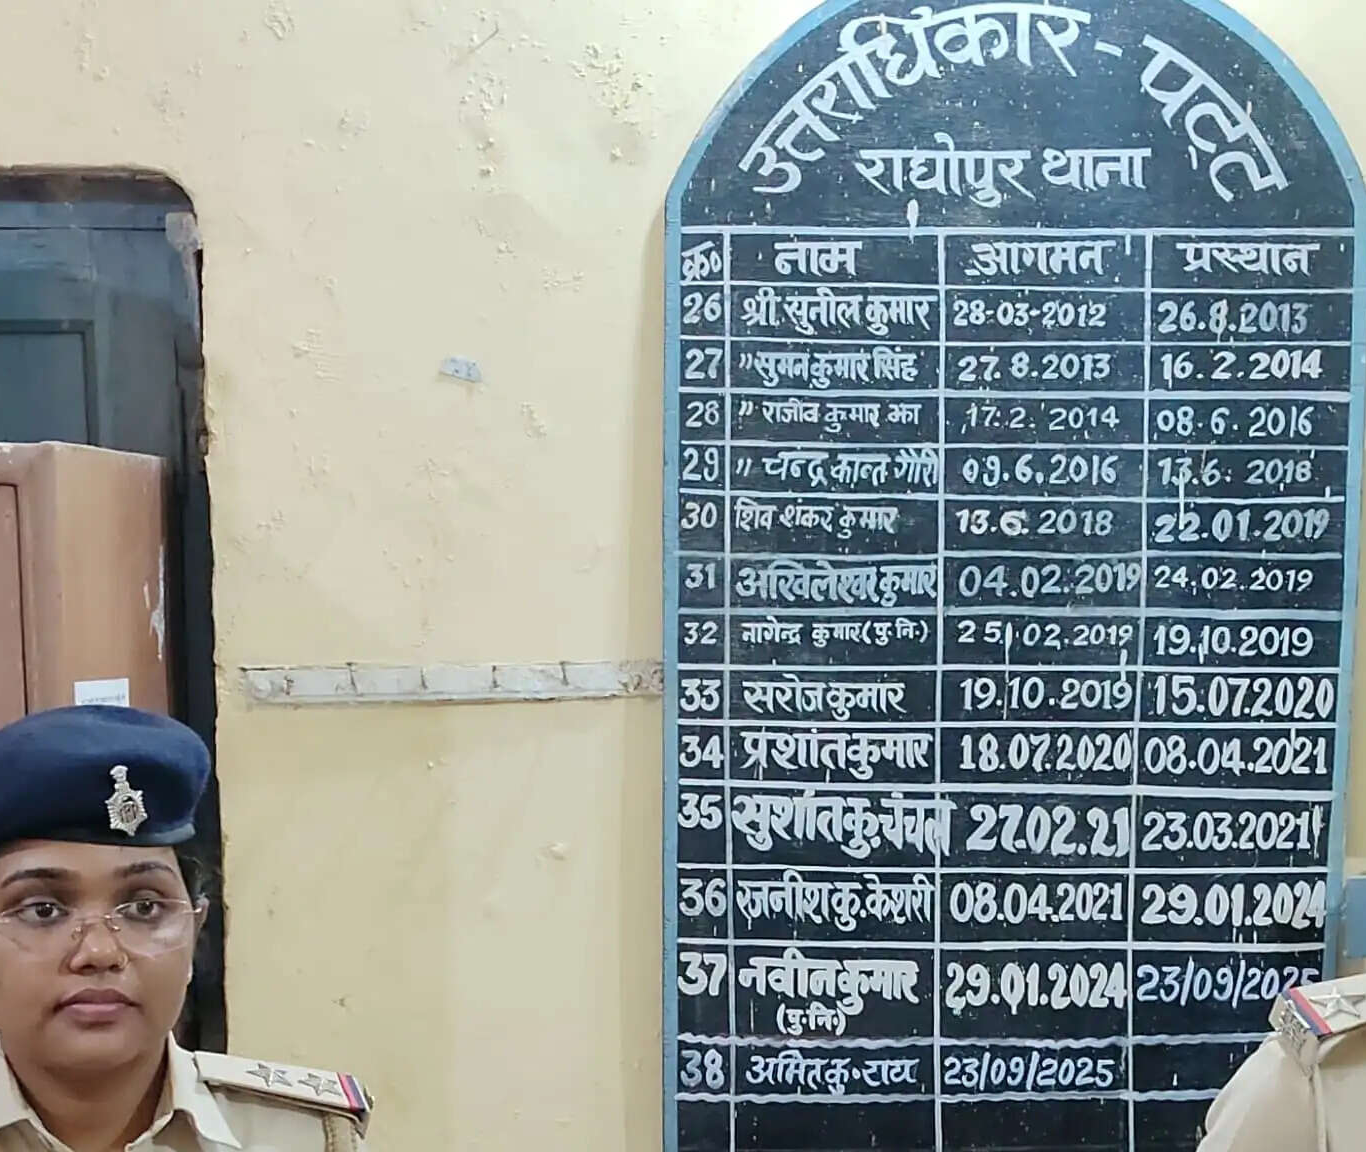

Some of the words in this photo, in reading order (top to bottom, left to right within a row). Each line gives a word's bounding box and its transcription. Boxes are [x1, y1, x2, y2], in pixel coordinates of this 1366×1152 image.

[855, 133, 1035, 207] राघोपुर
[1042, 147, 1152, 190] थाना
[774, 241, 862, 276] नाम
[965, 240, 1116, 276] आगमन
[1176, 242, 1320, 276] प्रस्थान
[683, 292, 722, 324] 26
[741, 286, 781, 326] श्री
[784, 287, 863, 335] सुनील
[865, 295, 938, 335] कुमार
[953, 299, 1106, 328] 28-03-2012
[1158, 300, 1307, 334] 26.8.2013
[685, 348, 724, 379] 27
[810, 352, 872, 388] कुमार
[873, 347, 918, 382] सिंह
[686, 400, 719, 427] 28
[762, 398, 820, 427] राजीव
[824, 403, 881, 433] कुमार
[682, 448, 719, 481] 29
[681, 501, 718, 529] 30
[734, 497, 777, 532] शिव
[779, 498, 834, 532] शंकर
[837, 506, 899, 539] कुमार
[1154, 507, 1330, 544] 22.01.2019
[686, 563, 716, 590] 31
[879, 564, 937, 607] कुमार
[958, 563, 1141, 598] 04.02.2019
[1154, 565, 1314, 594] 24.02.2019
[684, 622, 719, 645] 32
[741, 616, 803, 645] नागेन्द्र
[1153, 624, 1314, 659] 19.10.2019
[679, 678, 721, 712] 33
[960, 677, 1132, 711] 19.10.2019
[1153, 675, 1334, 720] 15.07.2020
[679, 735, 724, 769] 34
[960, 732, 1133, 772] 18.07.2020
[1143, 734, 1327, 776] 08.04.2021
[677, 793, 723, 829] 35
[965, 803, 1131, 858] 27.02.21
[1141, 810, 1313, 852] 23.03.2021
[679, 877, 726, 917] 36
[949, 881, 1123, 923] 08.04.2021
[1141, 879, 1326, 930] 29.01.2024
[677, 951, 727, 997] 37
[738, 947, 839, 998] नवीन
[837, 959, 920, 1015] कुमार
[947, 961, 1127, 1010] 29.01.2024
[680, 1049, 725, 1088] 38
[746, 1049, 827, 1089] अमित
[861, 1057, 920, 1087] राय
[943, 1051, 1115, 1090] 23/09/2025
